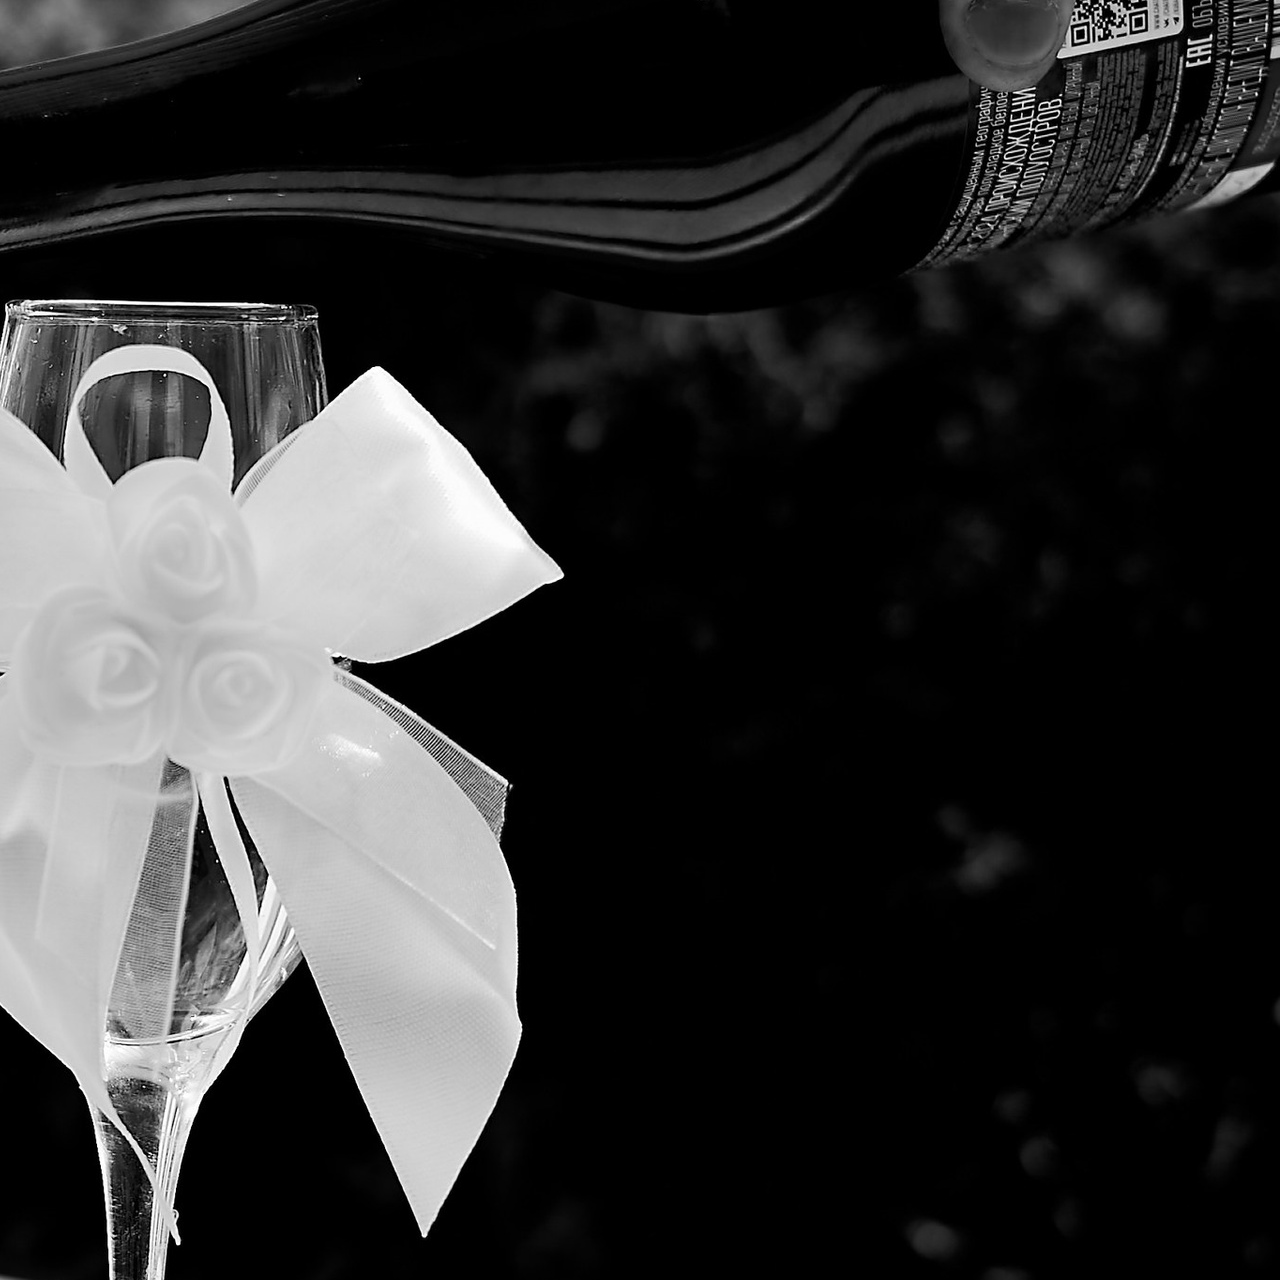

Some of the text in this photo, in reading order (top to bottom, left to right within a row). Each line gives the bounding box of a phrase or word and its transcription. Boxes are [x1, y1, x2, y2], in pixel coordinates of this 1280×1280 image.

[1214, 0, 1231, 56] условий
[990, 92, 1008, 127] белое
[977, 128, 1005, 197] полусладкое
[1015, 93, 1063, 197] ПОЛУОСТРОВ.
